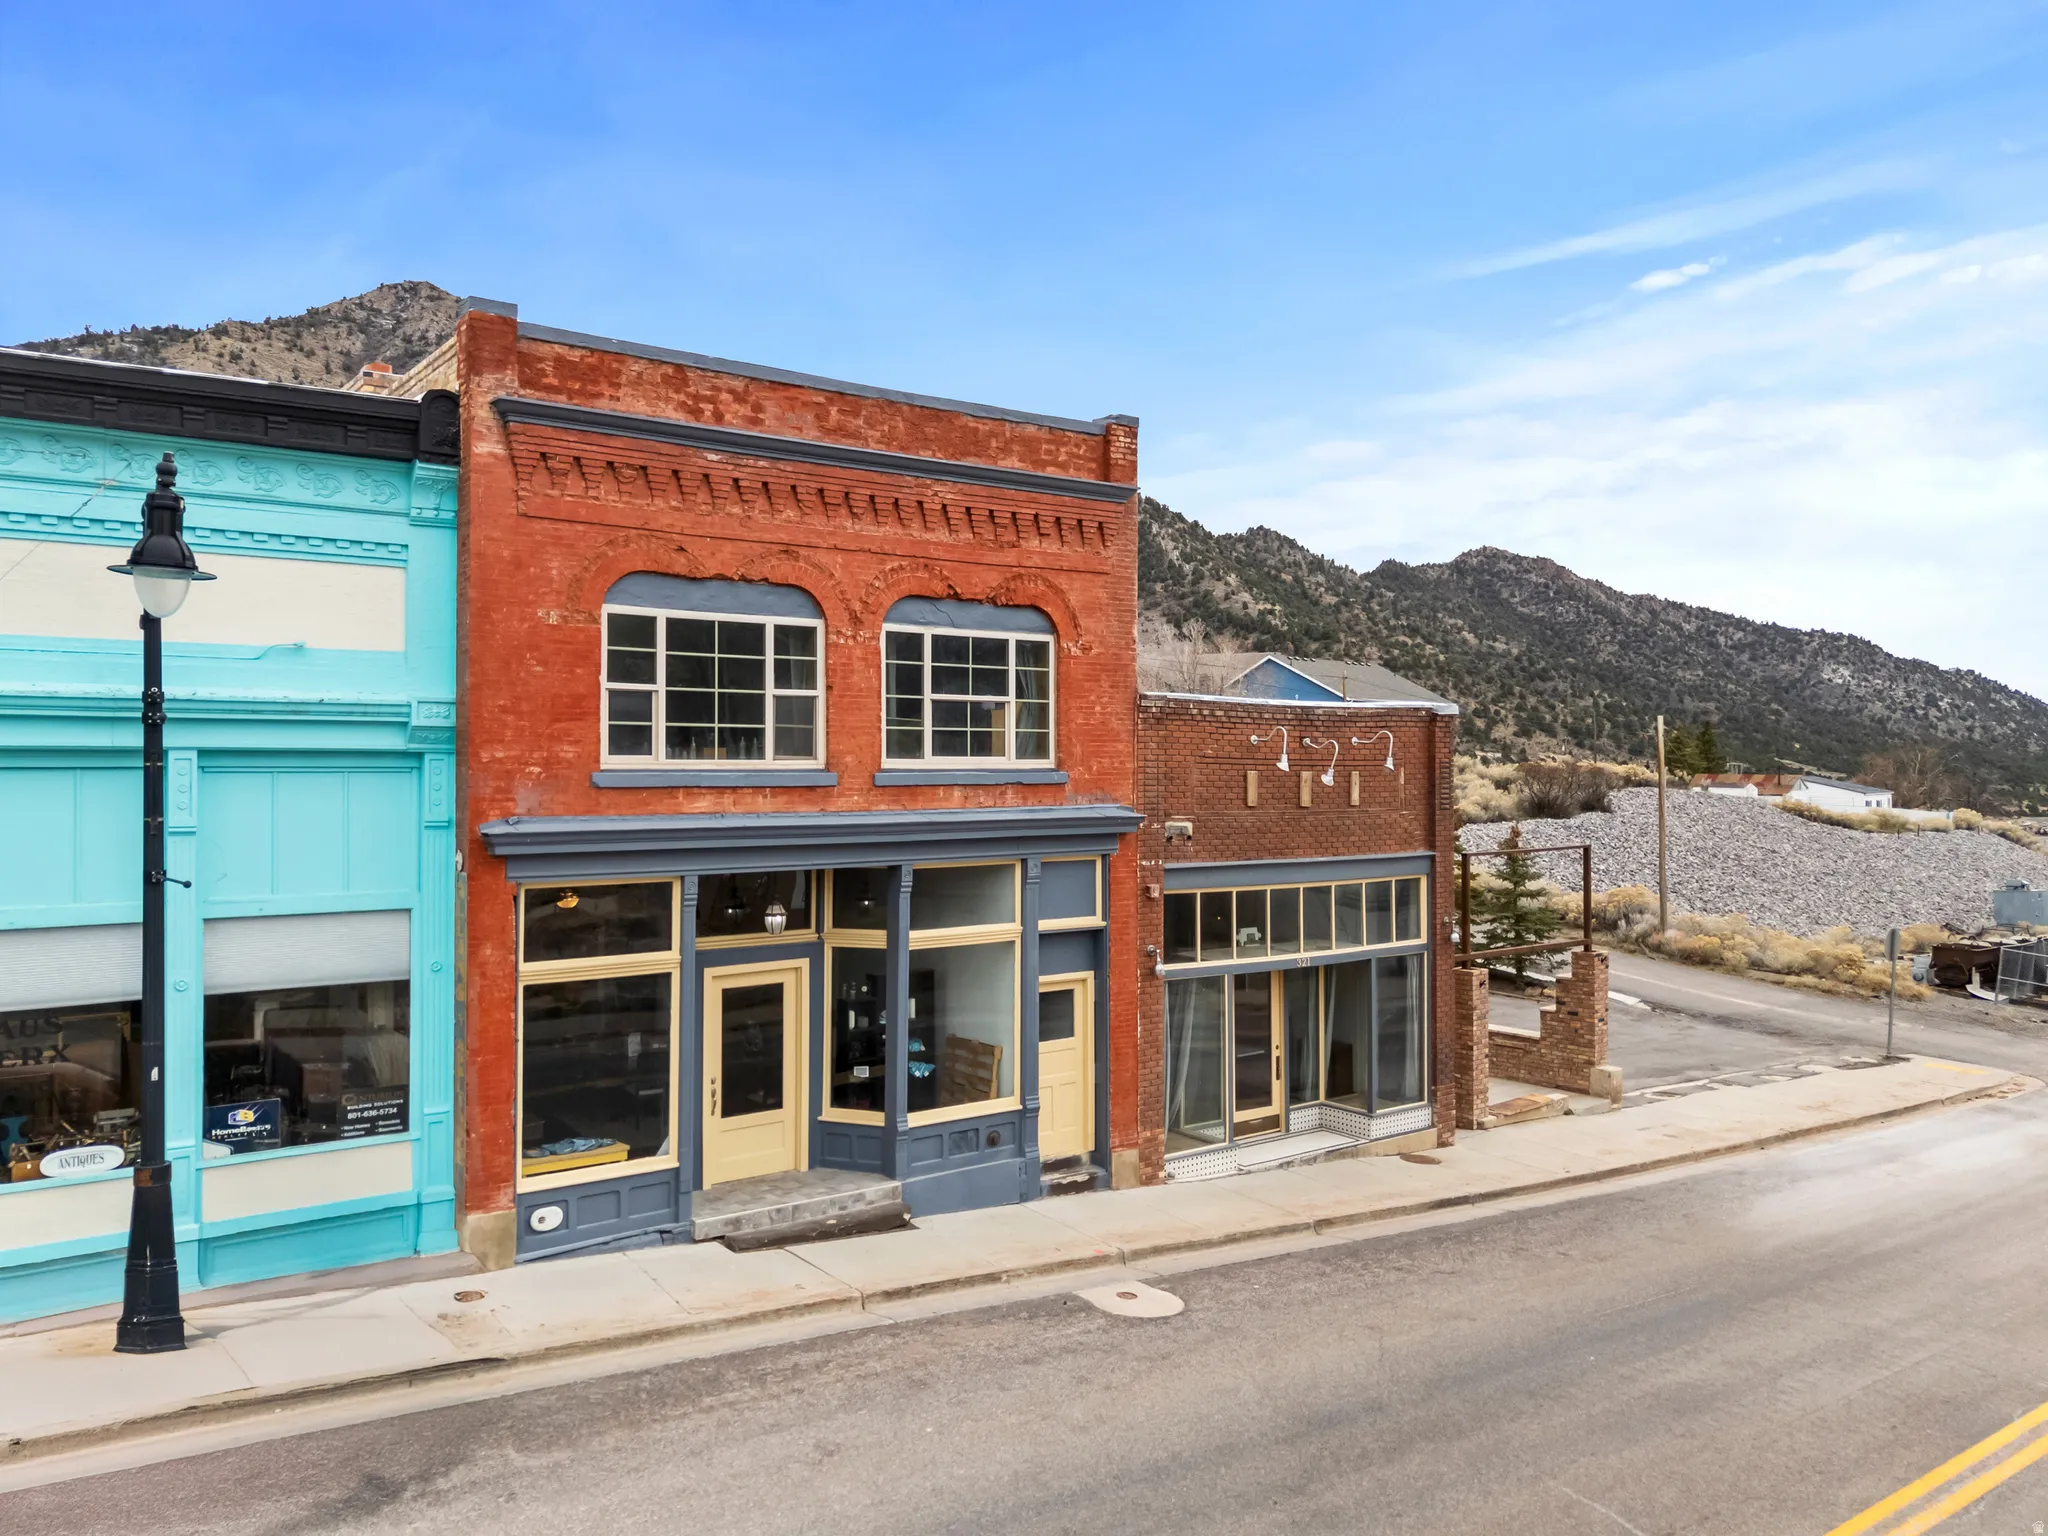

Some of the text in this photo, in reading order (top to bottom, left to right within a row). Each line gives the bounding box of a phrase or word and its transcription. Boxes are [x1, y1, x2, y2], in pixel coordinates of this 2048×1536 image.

[1296, 957, 1311, 967] 321
[347, 1107, 397, 1119] 801-636-5734
[59, 1153, 105, 1169] ANTIQUES
